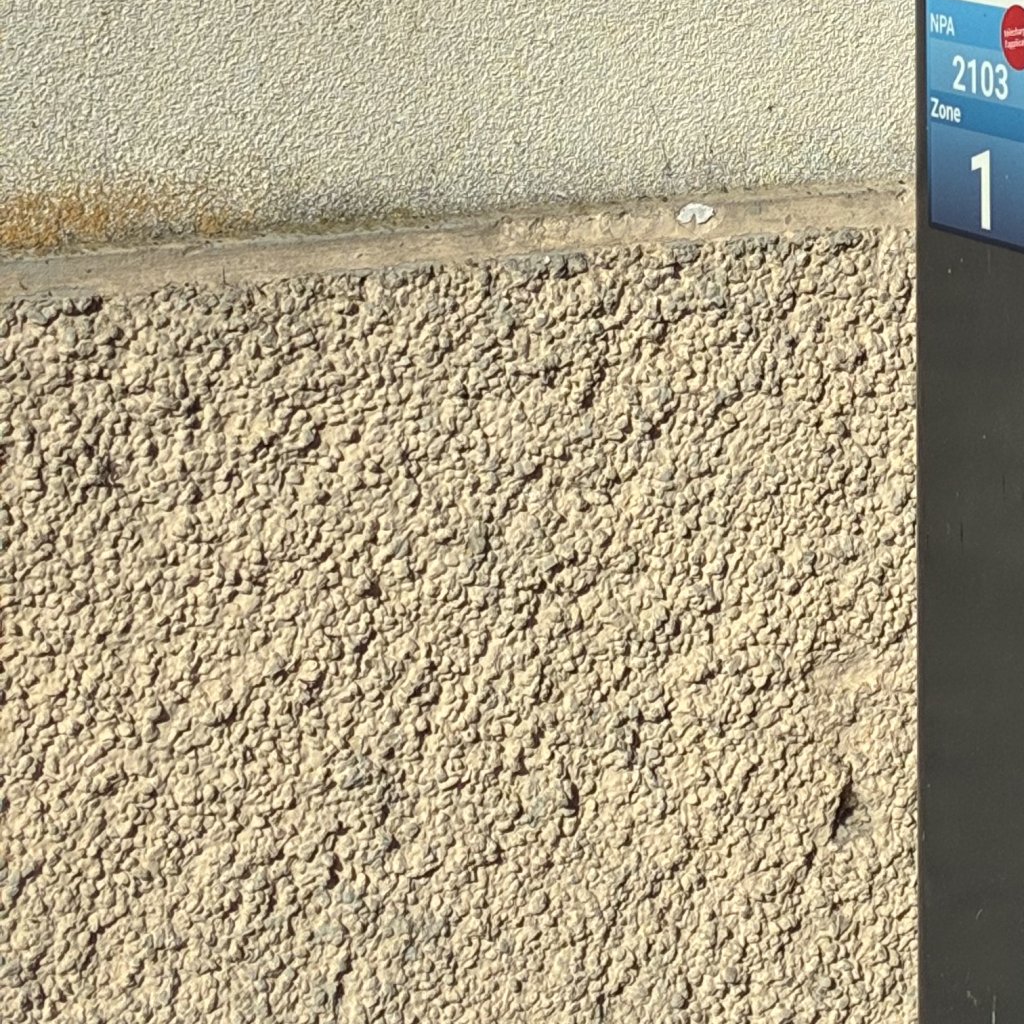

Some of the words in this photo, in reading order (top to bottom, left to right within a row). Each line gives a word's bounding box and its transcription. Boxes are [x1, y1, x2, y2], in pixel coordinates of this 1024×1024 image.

[930, 13, 955, 37] NPA
[952, 55, 1009, 100] 2103
[930, 98, 961, 123] Zone
[971, 149, 991, 230] 1
